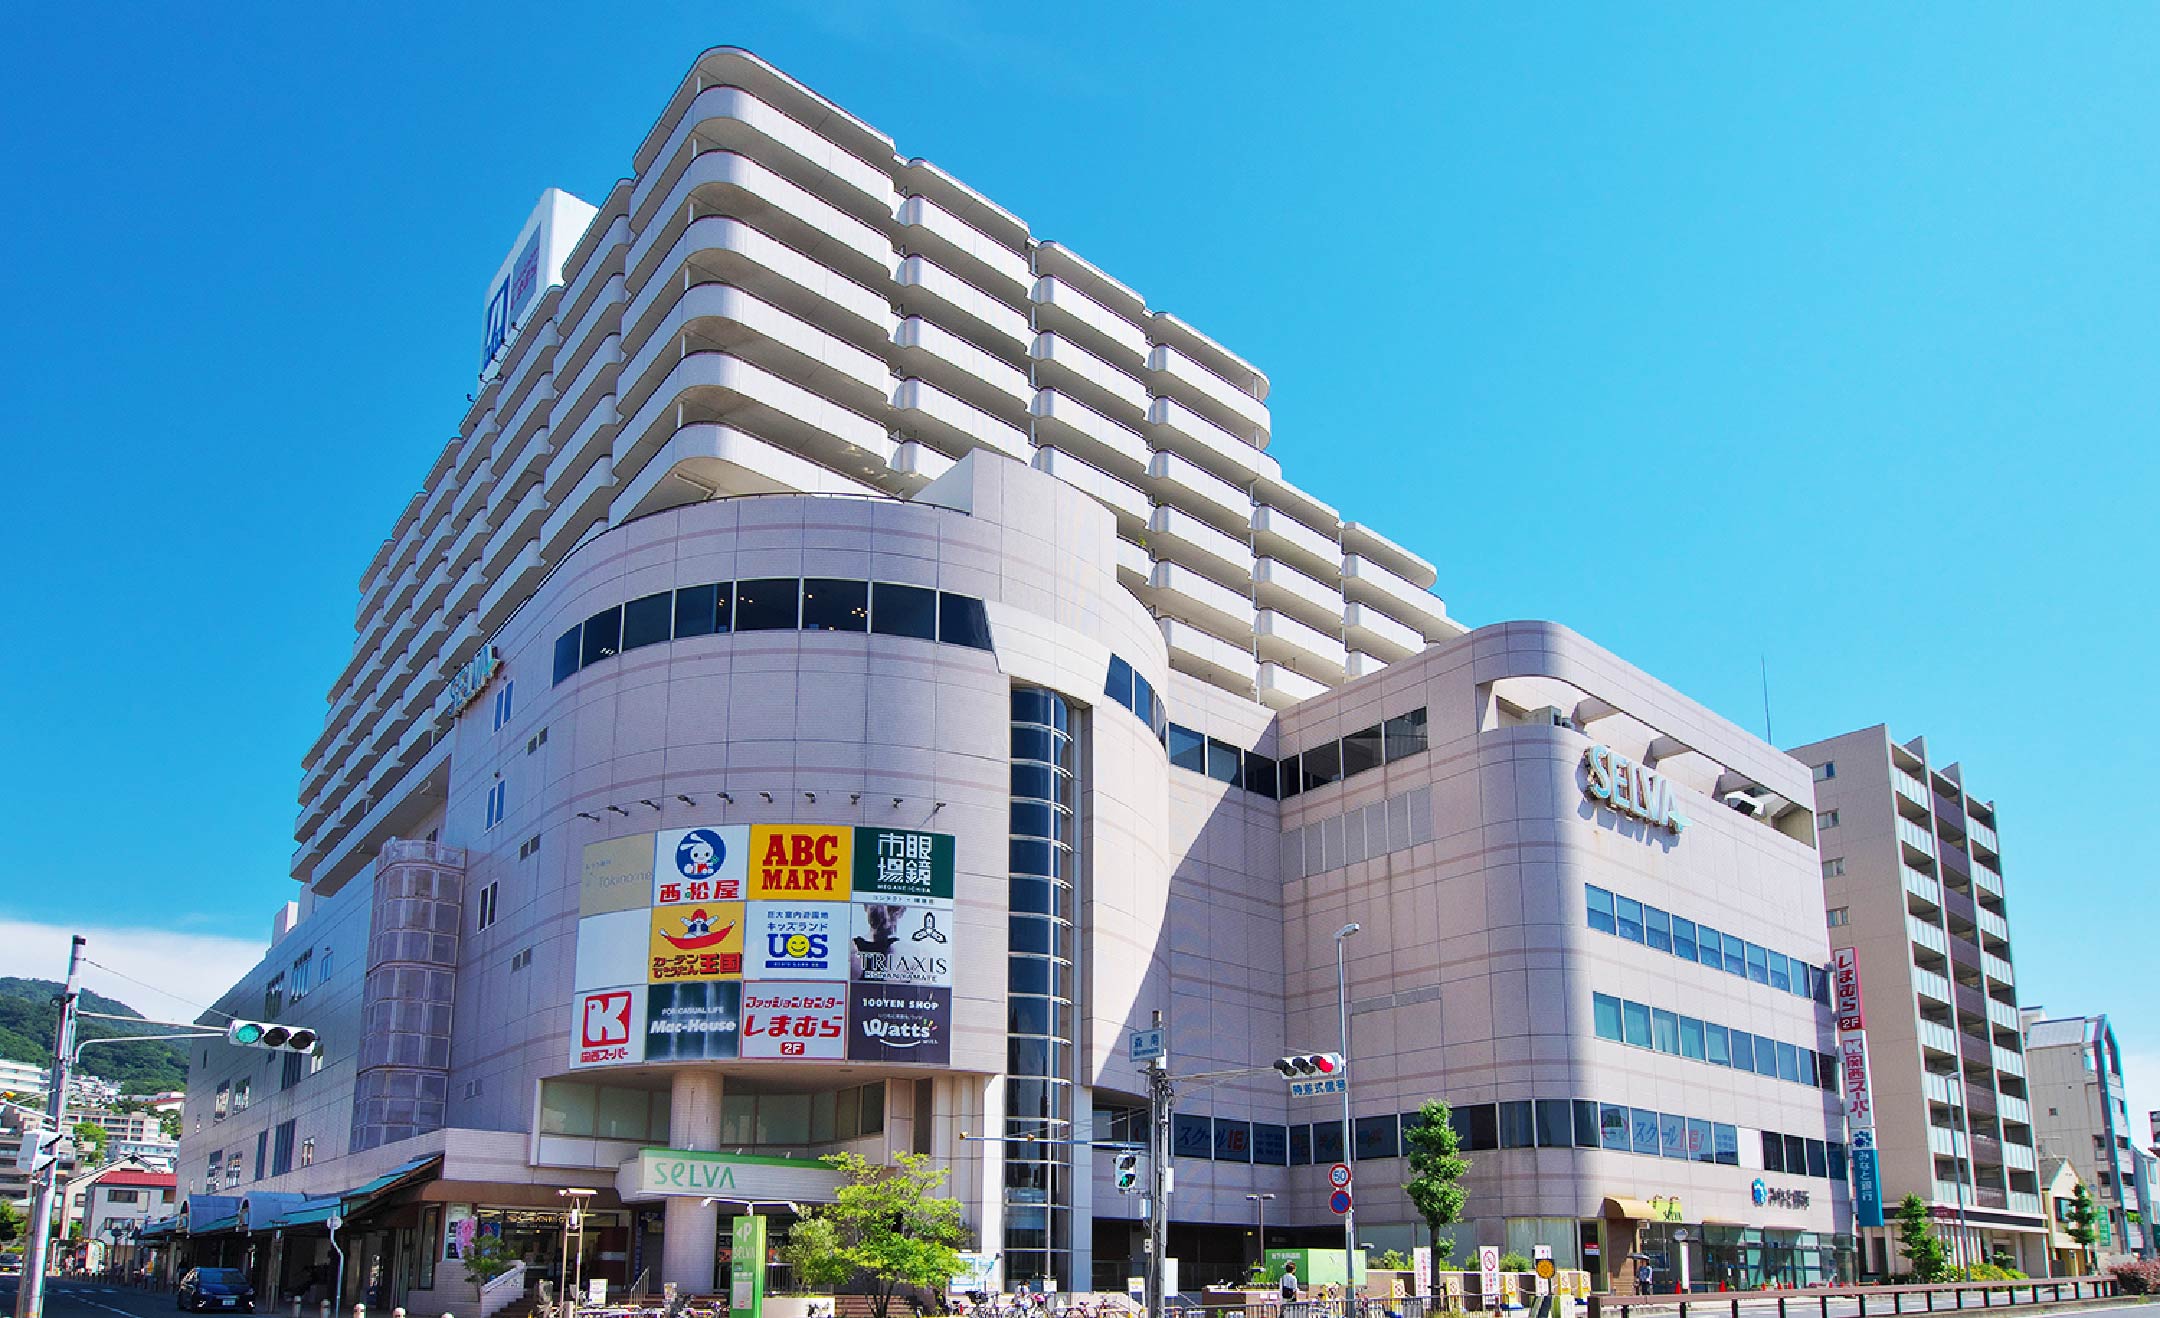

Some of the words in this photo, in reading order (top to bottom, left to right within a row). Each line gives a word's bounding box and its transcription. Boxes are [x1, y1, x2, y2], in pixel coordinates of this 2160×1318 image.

[1588, 744, 1692, 832] SELVA
[763, 834, 838, 867] ABC
[762, 869, 838, 890] MART
[660, 880, 740, 903] 西松屋
[767, 922, 828, 932] キッズランド
[700, 952, 742, 975] 王国
[862, 951, 948, 975] TRIAXIS
[1838, 954, 1857, 1012] しまむら
[679, 1006, 707, 1015] CASUAL
[708, 1006, 724, 1014] LIFE
[745, 996, 844, 1008] ファッションセンター
[909, 1001, 939, 1010] SHOP
[650, 1019, 737, 1035] Mac-House
[744, 1014, 843, 1037] しまむら
[862, 1018, 931, 1038] Watts
[1842, 1017, 1860, 1029] 2F
[784, 1043, 802, 1054] 2F
[1846, 1055, 1869, 1119] 関西スーパー
[1333, 1170, 1347, 1182] 50
